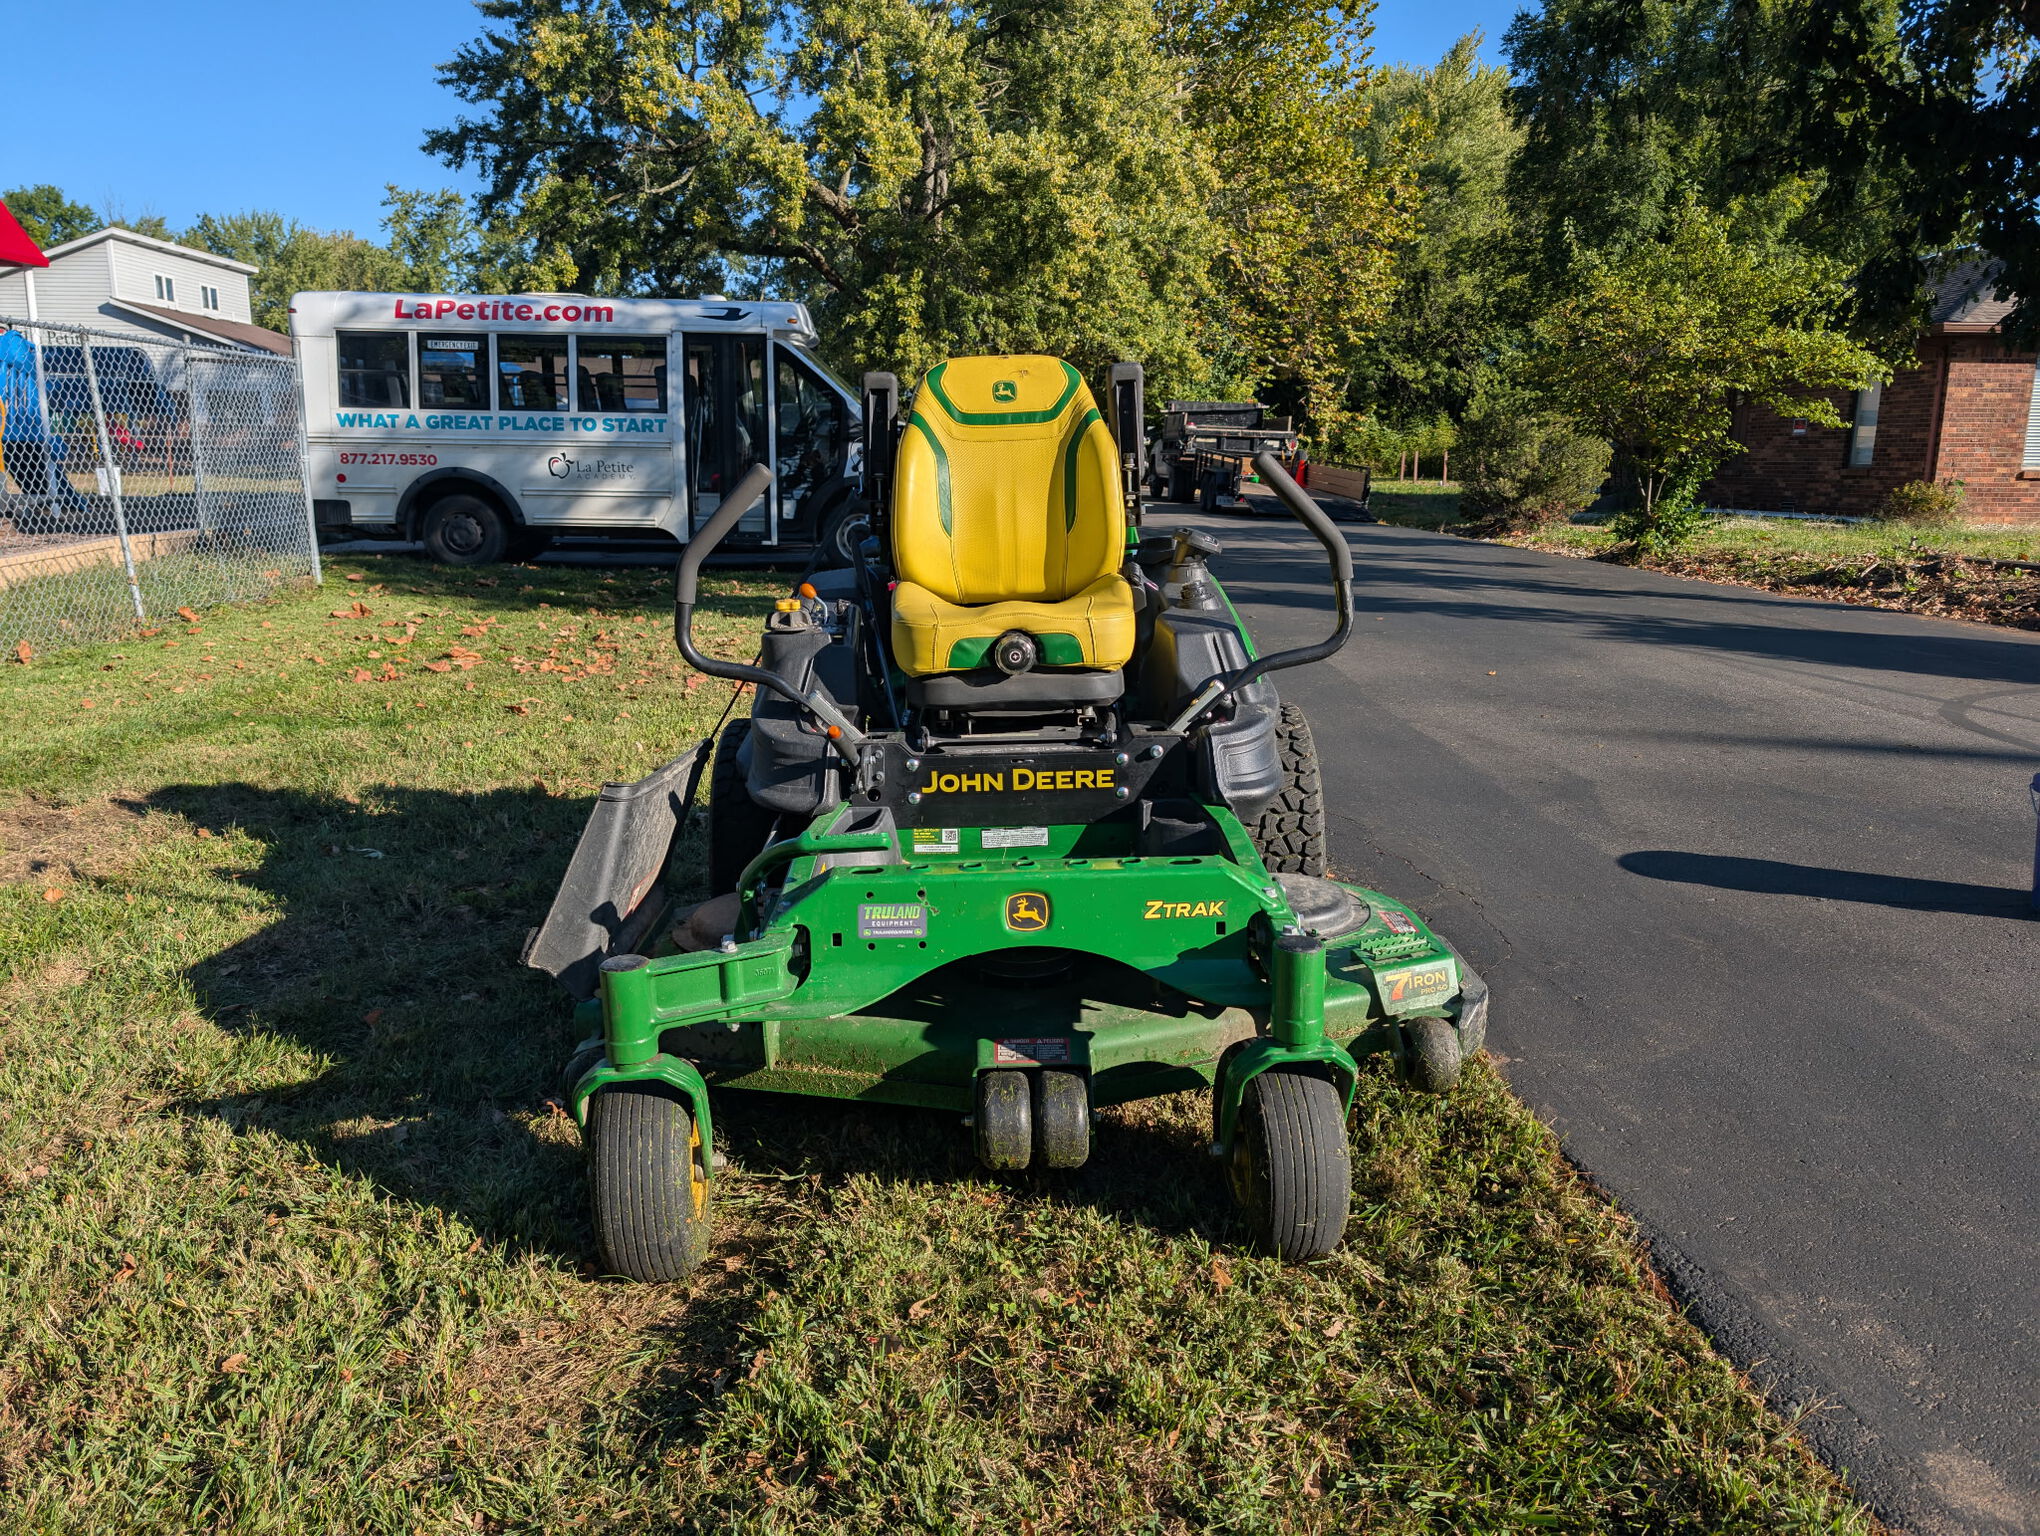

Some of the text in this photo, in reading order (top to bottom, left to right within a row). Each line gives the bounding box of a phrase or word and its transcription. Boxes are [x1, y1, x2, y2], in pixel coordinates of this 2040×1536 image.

[394, 299, 614, 323] LaPetite.com
[336, 413, 667, 433] WHAT A GREAT PLACE TO START
[340, 452, 438, 466] 877.217.9530
[576, 460, 634, 473] La Petite
[921, 768, 1115, 794] JOHN DEERE
[864, 905, 921, 920] TRULAND
[1144, 900, 1225, 919] ZTRAK
[1384, 970, 1447, 1001] 7 IRON
